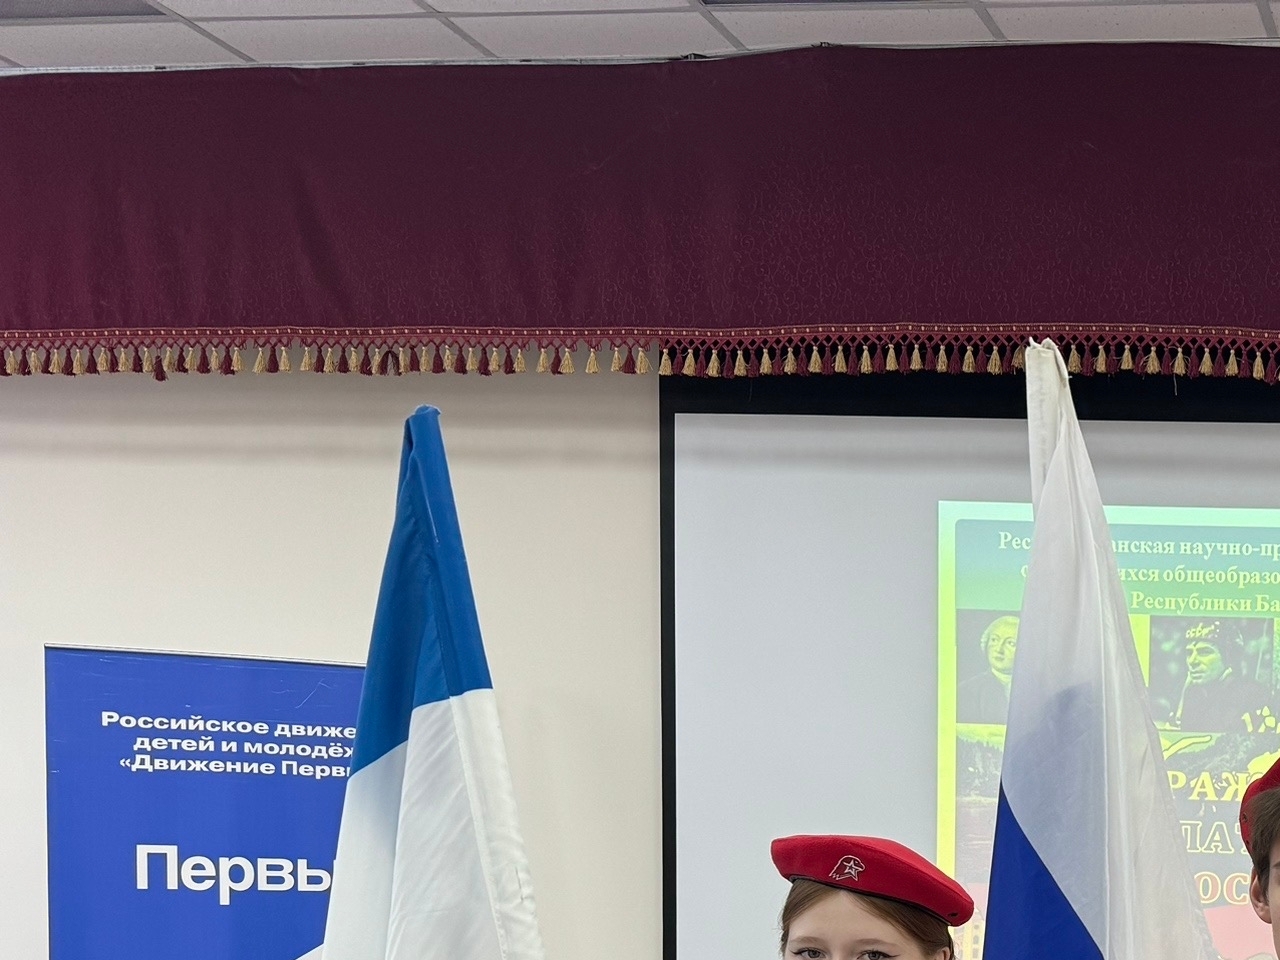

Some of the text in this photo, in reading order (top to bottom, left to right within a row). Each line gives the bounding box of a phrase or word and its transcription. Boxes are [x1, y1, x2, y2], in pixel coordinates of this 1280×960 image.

[1130, 591, 1252, 614] Республики
[101, 711, 357, 739] Российское движе
[132, 736, 215, 752] детей
[221, 741, 238, 753] и
[119, 754, 350, 780] «Движение Перв
